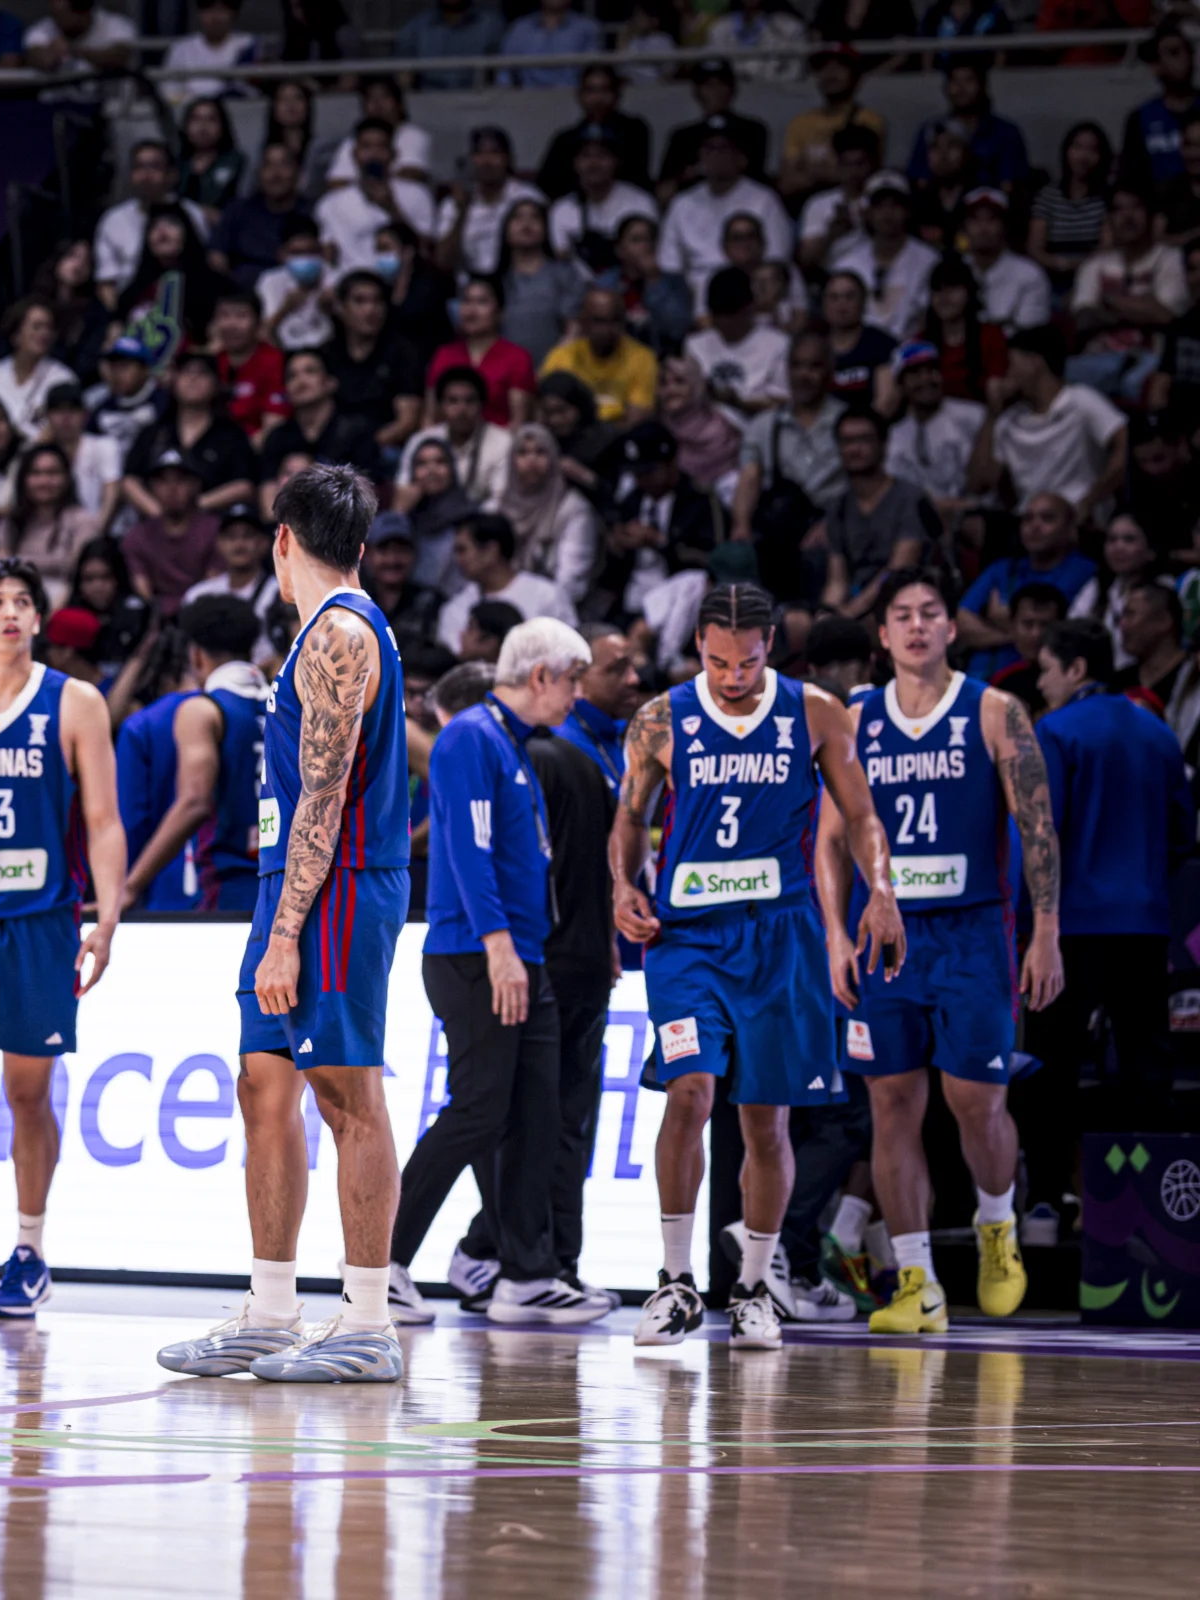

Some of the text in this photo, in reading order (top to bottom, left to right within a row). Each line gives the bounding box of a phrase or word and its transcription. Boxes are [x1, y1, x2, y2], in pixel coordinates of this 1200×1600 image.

[690, 753, 791, 788] PILIPINAS
[867, 749, 966, 786] PILIPINAS
[259, 812, 275, 833] art
[716, 795, 742, 848] 3
[895, 792, 938, 844] 24
[707, 870, 770, 893] Smart
[901, 866, 959, 886] Smart
